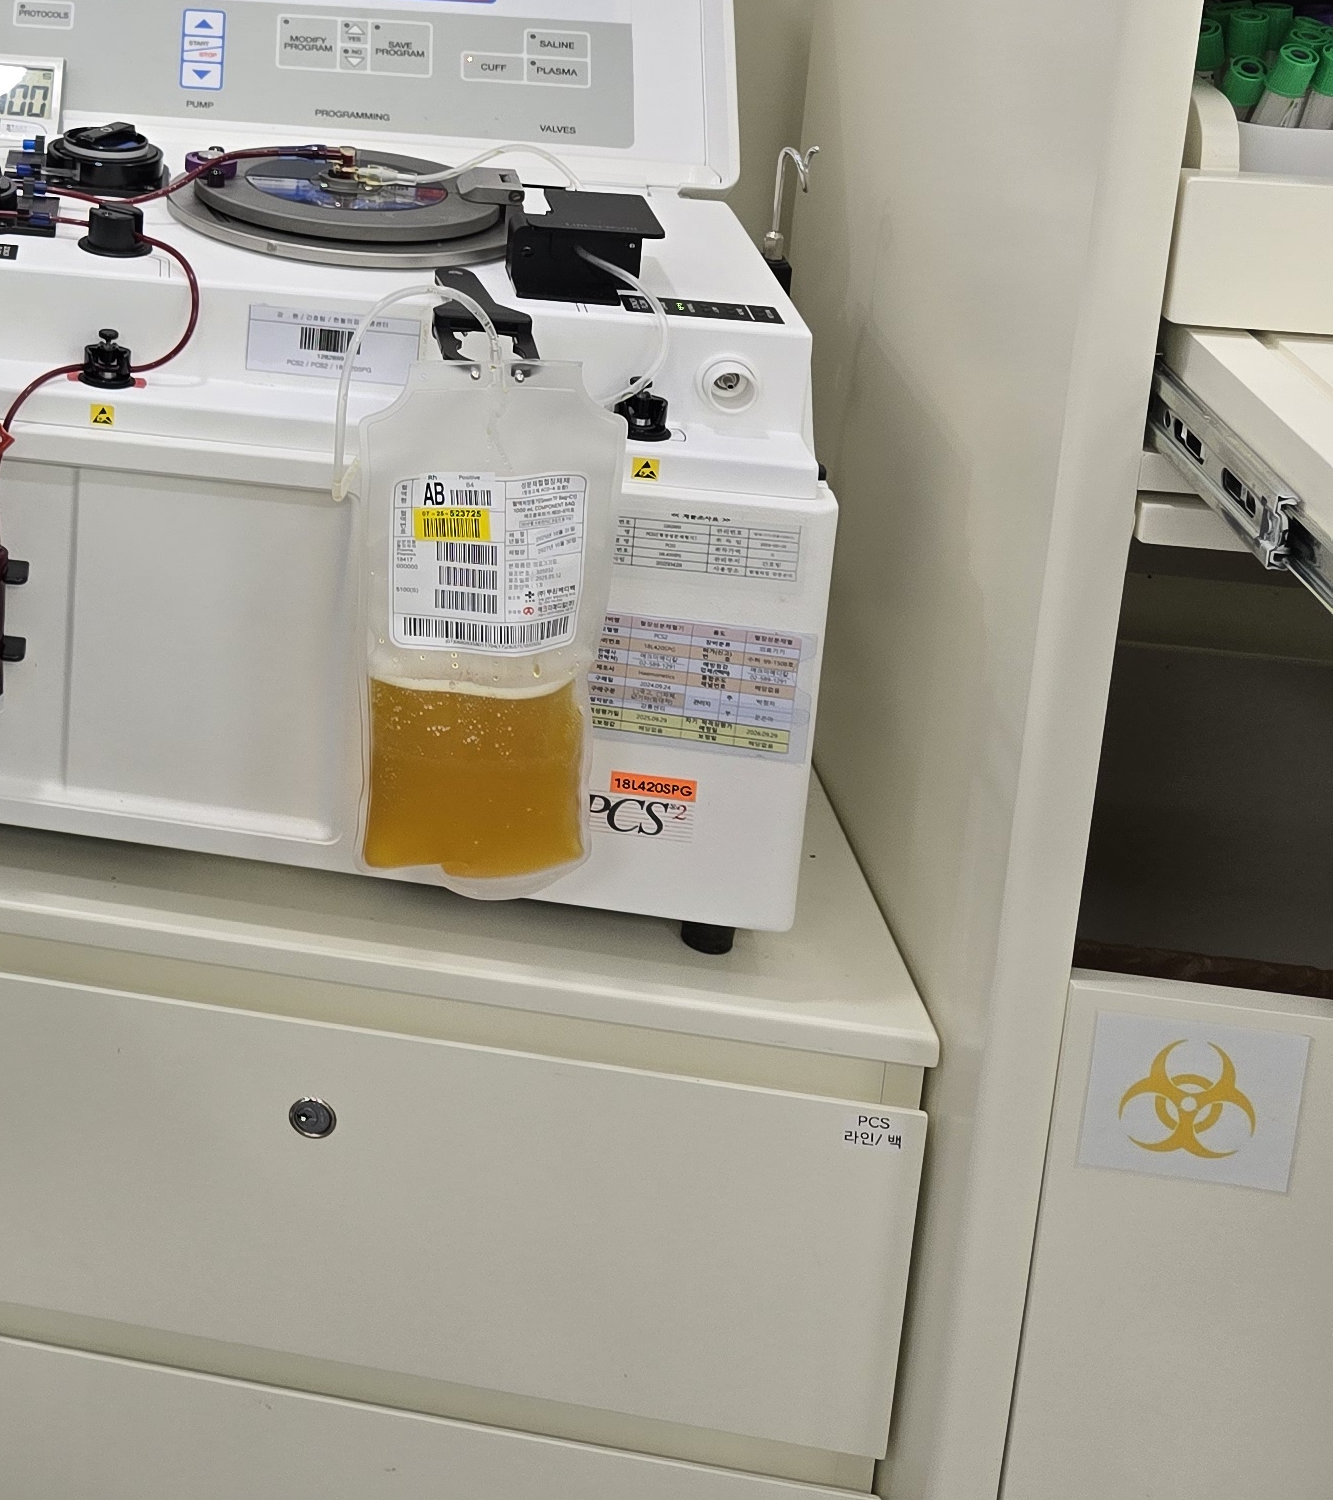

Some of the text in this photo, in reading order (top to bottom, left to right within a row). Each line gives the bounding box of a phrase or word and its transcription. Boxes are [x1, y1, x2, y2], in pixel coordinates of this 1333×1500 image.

[18, 9, 69, 19] PROTOCOLS
[290, 35, 327, 44] MODIFY
[283, 43, 333, 53] PROGRAM
[388, 41, 413, 50] SAVE
[539, 40, 575, 50] SALINE
[375, 48, 425, 58] PROGRAM
[480, 63, 507, 72] CUFF
[536, 67, 578, 77] PLASMA
[186, 100, 214, 109] PUMP
[315, 109, 390, 122] PROGRAMMING
[539, 125, 576, 135] VALVES
[286, 359, 328, 370] PCS2 PCS2
[423, 482, 446, 506] AB
[535, 502, 563, 511] COMPONENT
[614, 778, 693, 797] 18L420SPG
[858, 1115, 890, 1129] PCS
[888, 1134, 901, 1149] 백
